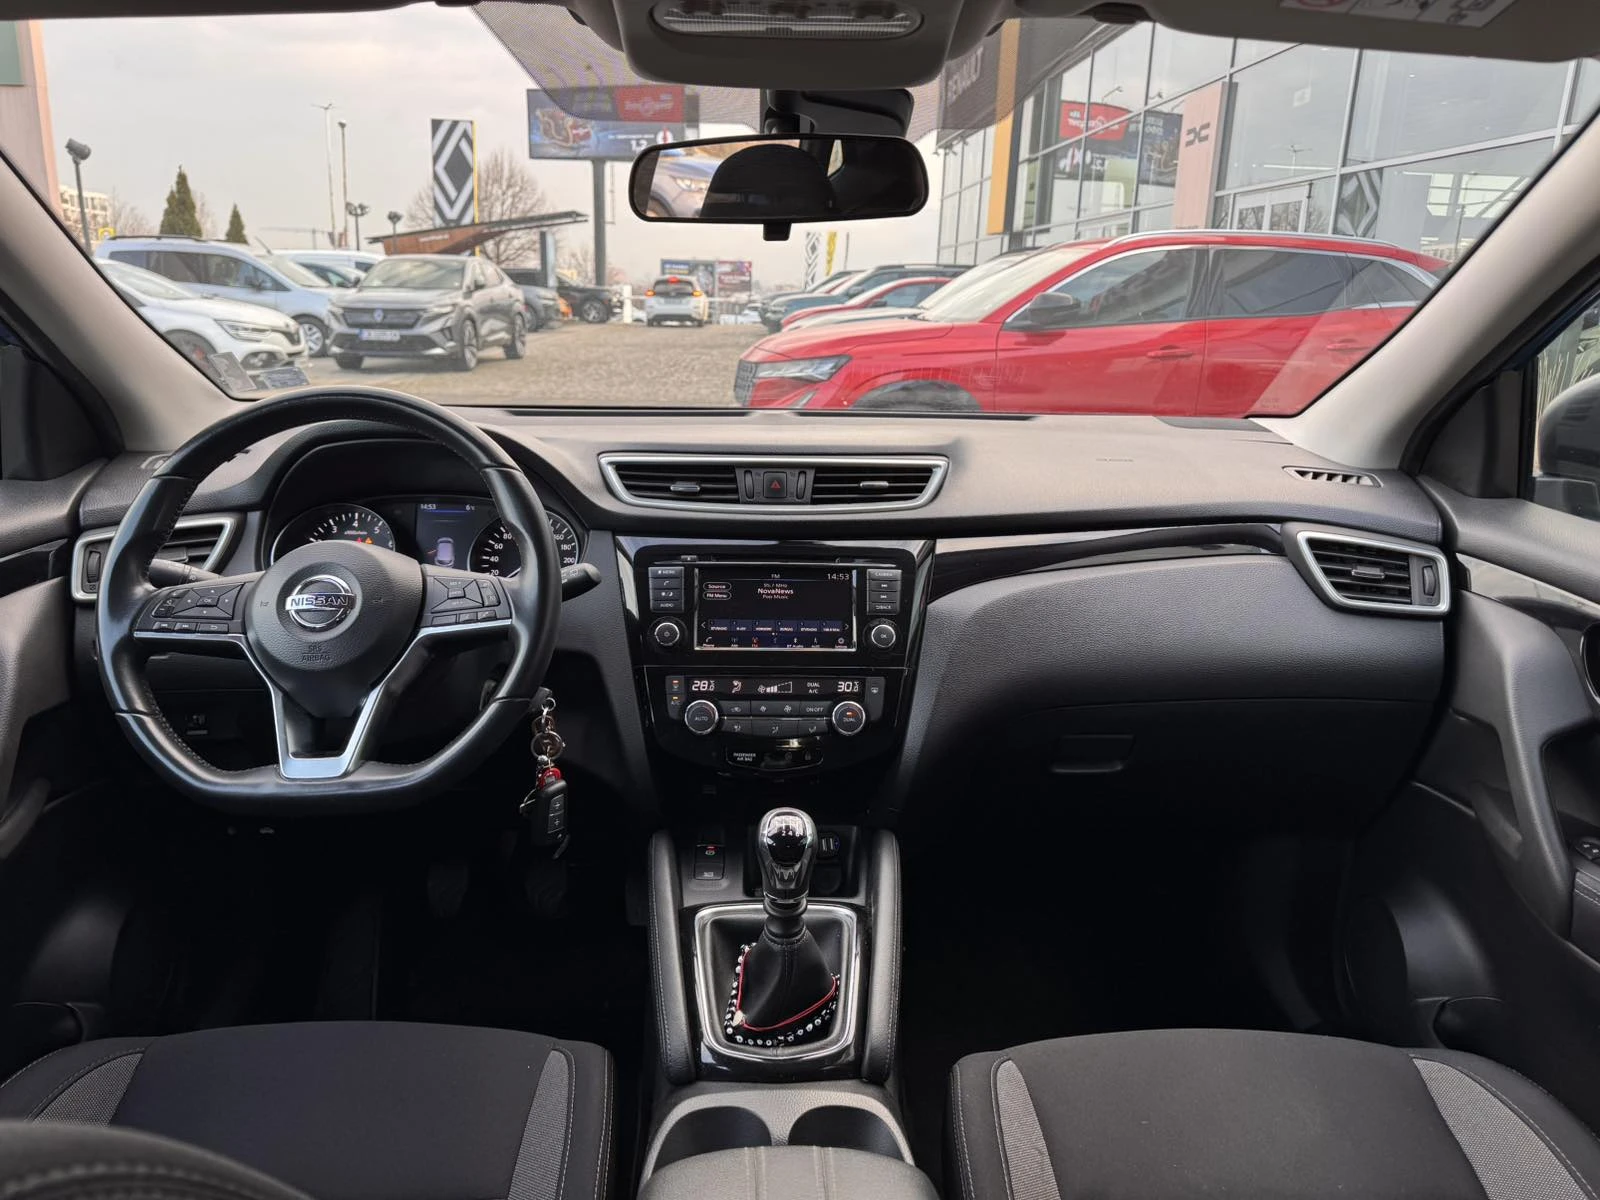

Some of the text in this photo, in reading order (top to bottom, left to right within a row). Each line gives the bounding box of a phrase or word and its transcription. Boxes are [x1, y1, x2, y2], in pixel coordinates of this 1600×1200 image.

[352, 520, 359, 528] 4
[332, 525, 338, 533] 3
[374, 526, 380, 534] 5
[290, 596, 348, 607] NISSAN
